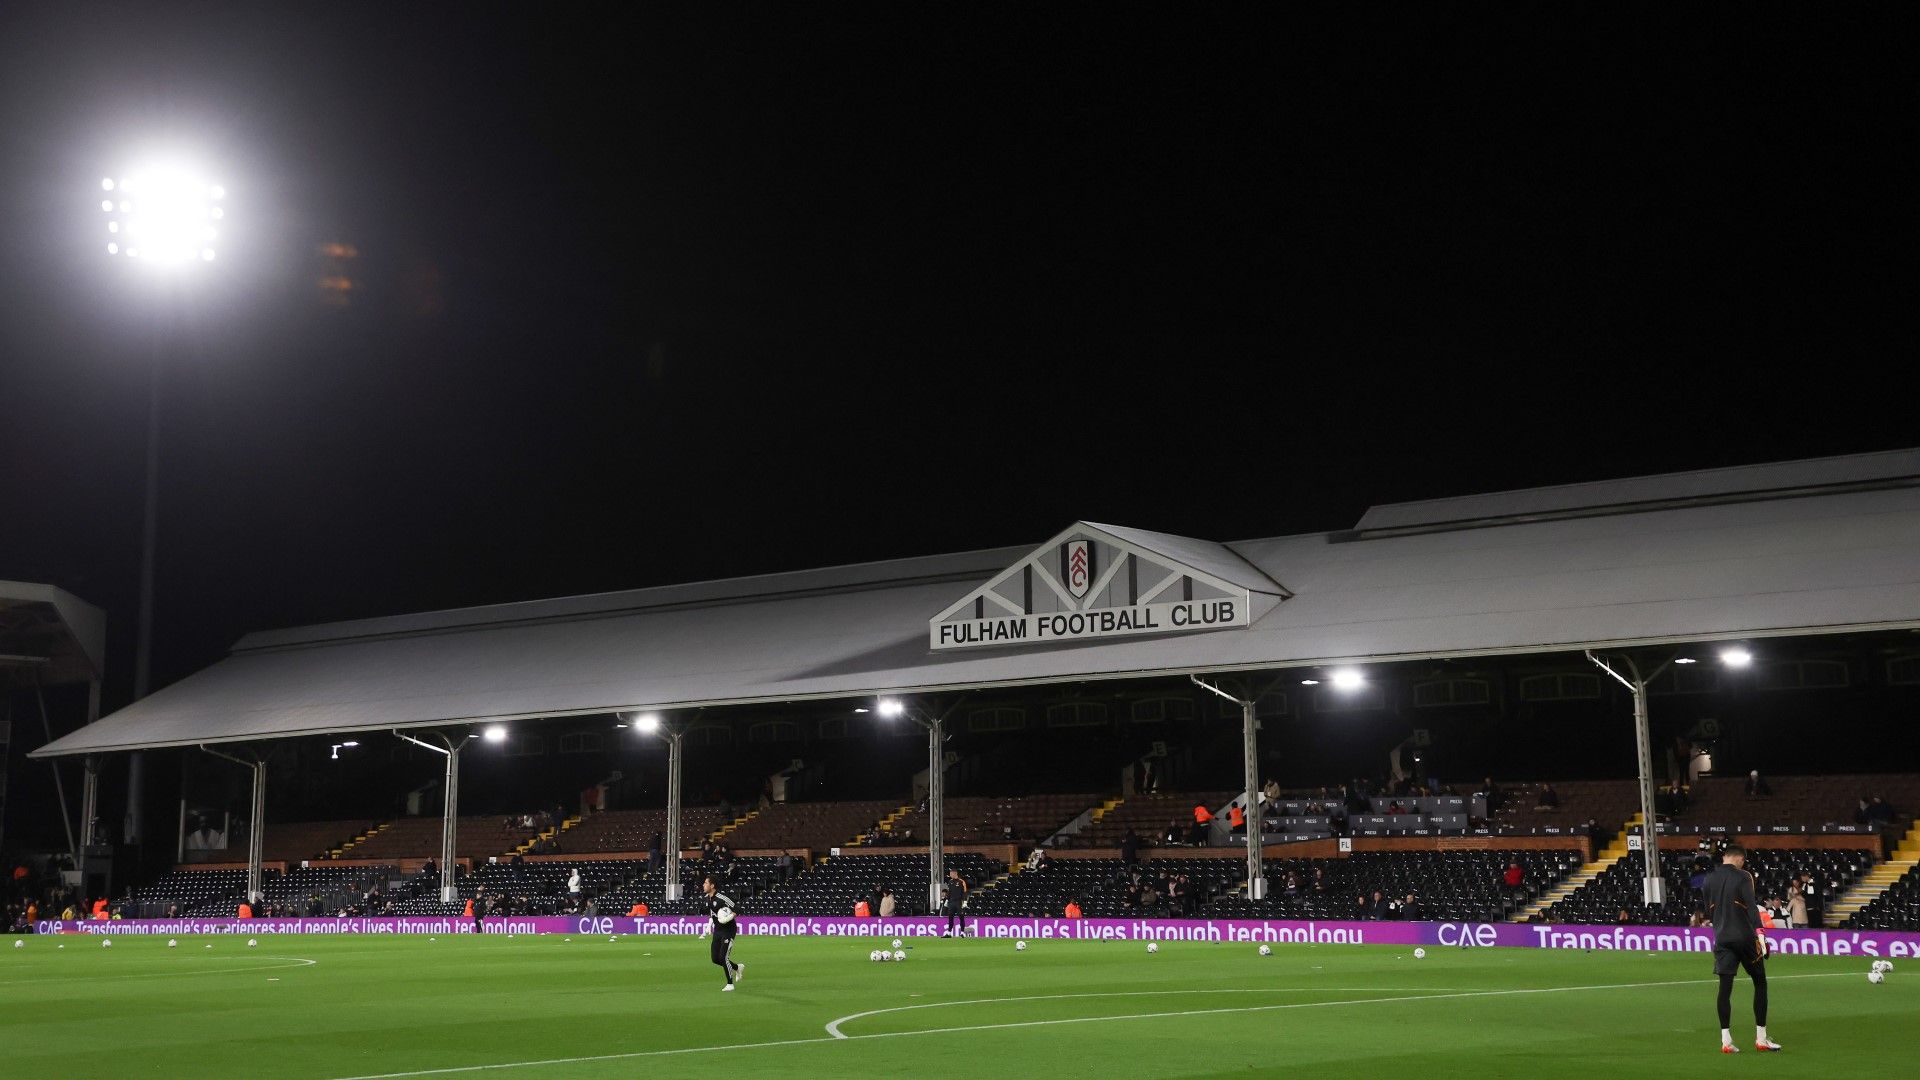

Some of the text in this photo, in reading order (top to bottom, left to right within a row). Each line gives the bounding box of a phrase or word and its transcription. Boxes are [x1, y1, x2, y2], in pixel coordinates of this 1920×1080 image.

[939, 601, 1235, 645] FULHAM FOOTBALL CLUB
[1710, 825, 1726, 833] PRESS
[1773, 825, 1789, 833] PRESS
[1838, 825, 1856, 833] PRESS
[1341, 841, 1350, 849] FL
[279, 918, 301, 934] and
[362, 918, 394, 934] lives
[1076, 920, 1127, 940] lives
[1533, 925, 1714, 952] Transformin
